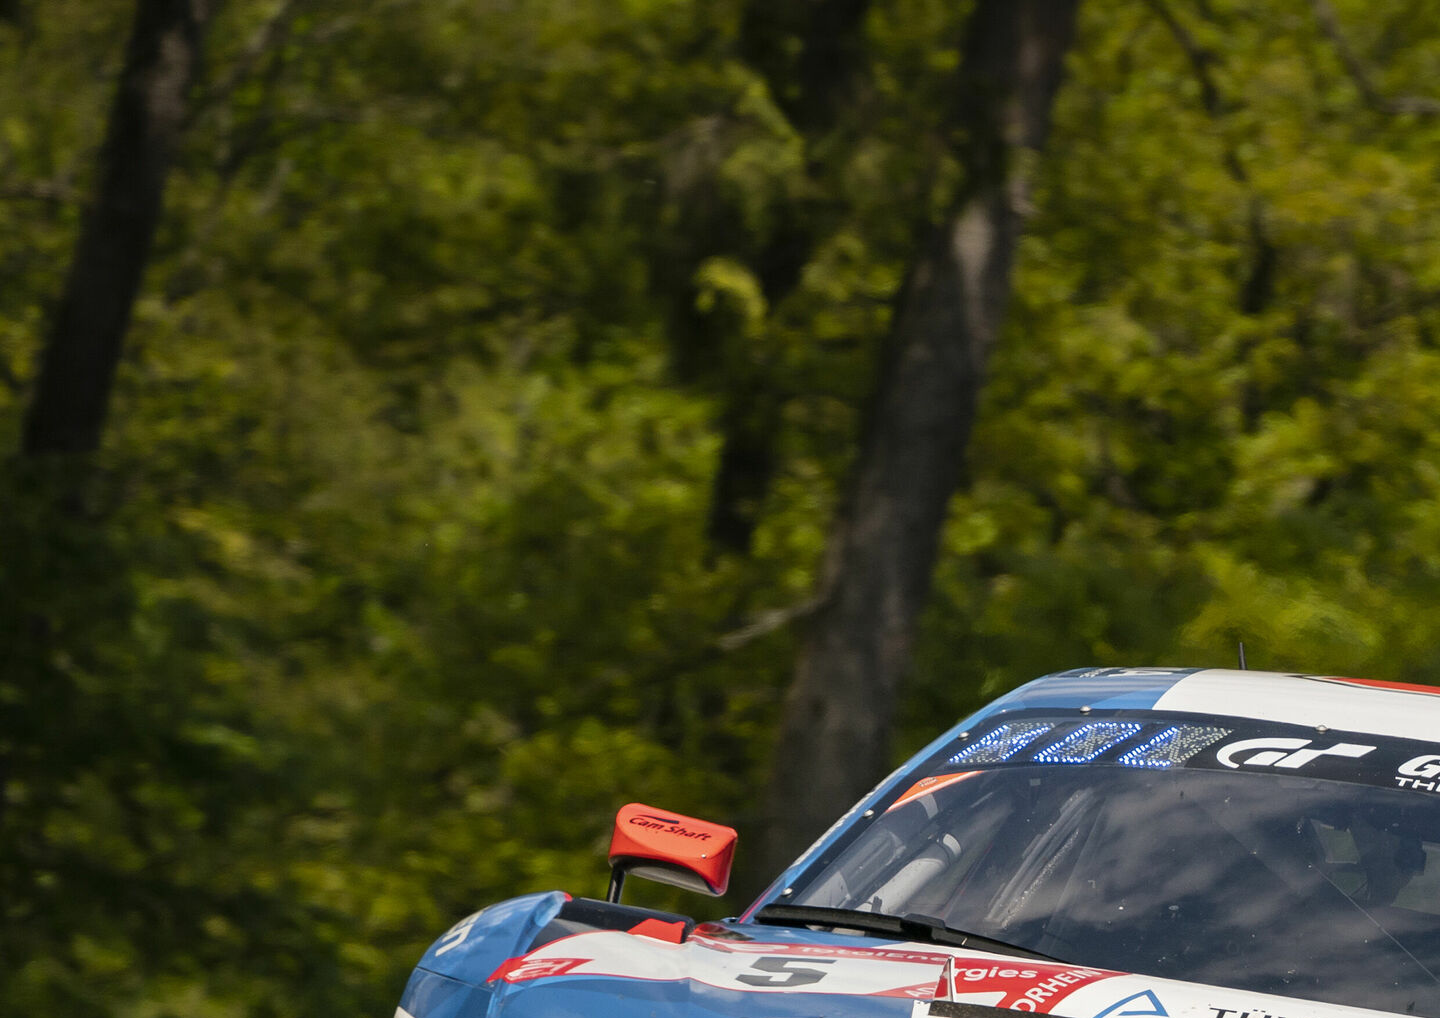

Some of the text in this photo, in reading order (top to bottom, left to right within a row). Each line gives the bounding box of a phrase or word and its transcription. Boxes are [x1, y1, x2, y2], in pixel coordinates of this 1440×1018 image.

[629, 817, 712, 841] Cam Shaft
[735, 956, 837, 987] 5
